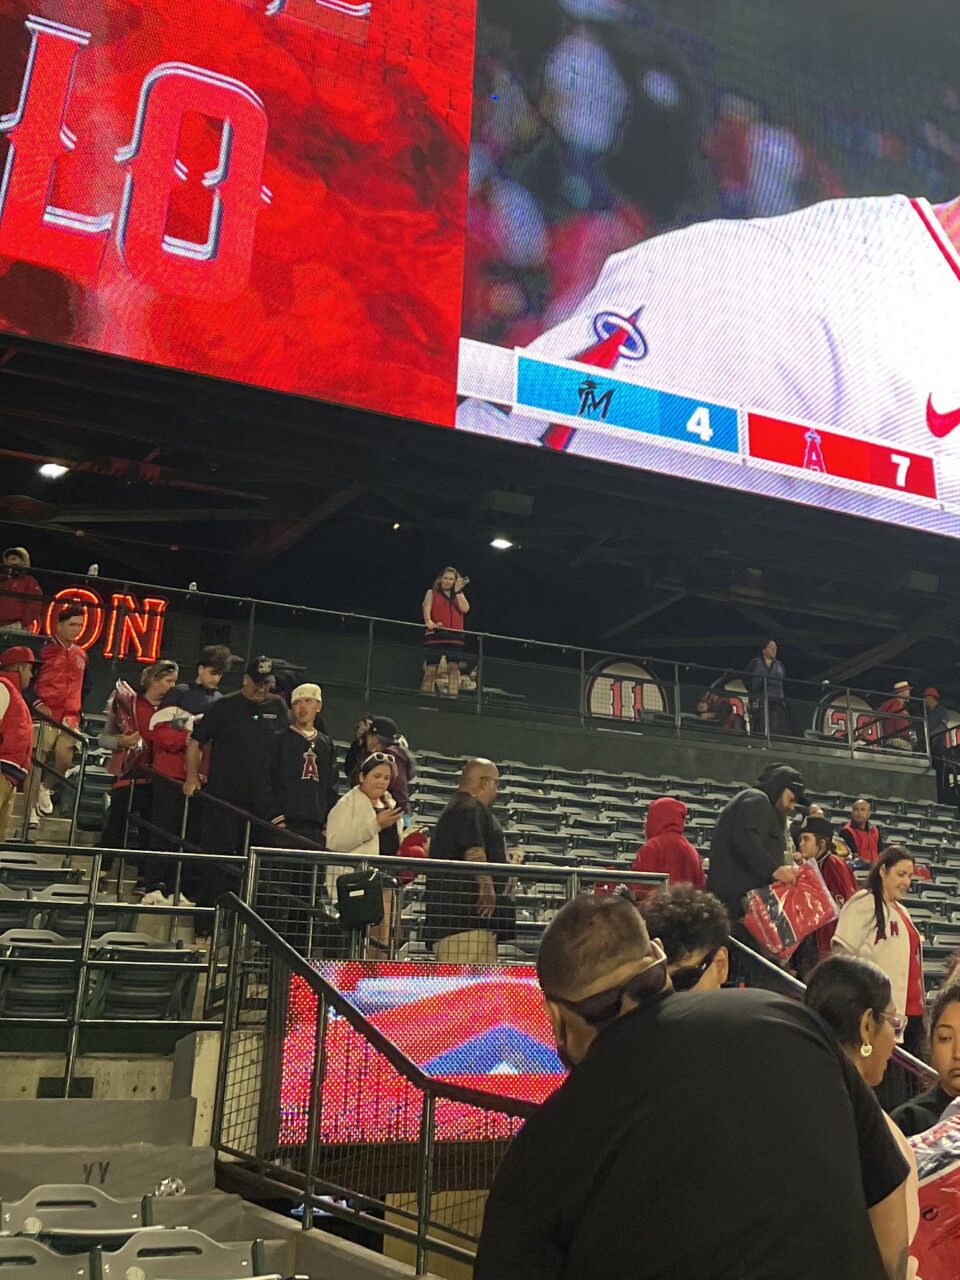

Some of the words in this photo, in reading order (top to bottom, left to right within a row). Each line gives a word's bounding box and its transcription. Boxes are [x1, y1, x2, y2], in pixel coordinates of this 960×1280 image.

[686, 406, 714, 441] 4
[890, 453, 911, 487] 7
[33, 584, 168, 663] ON
